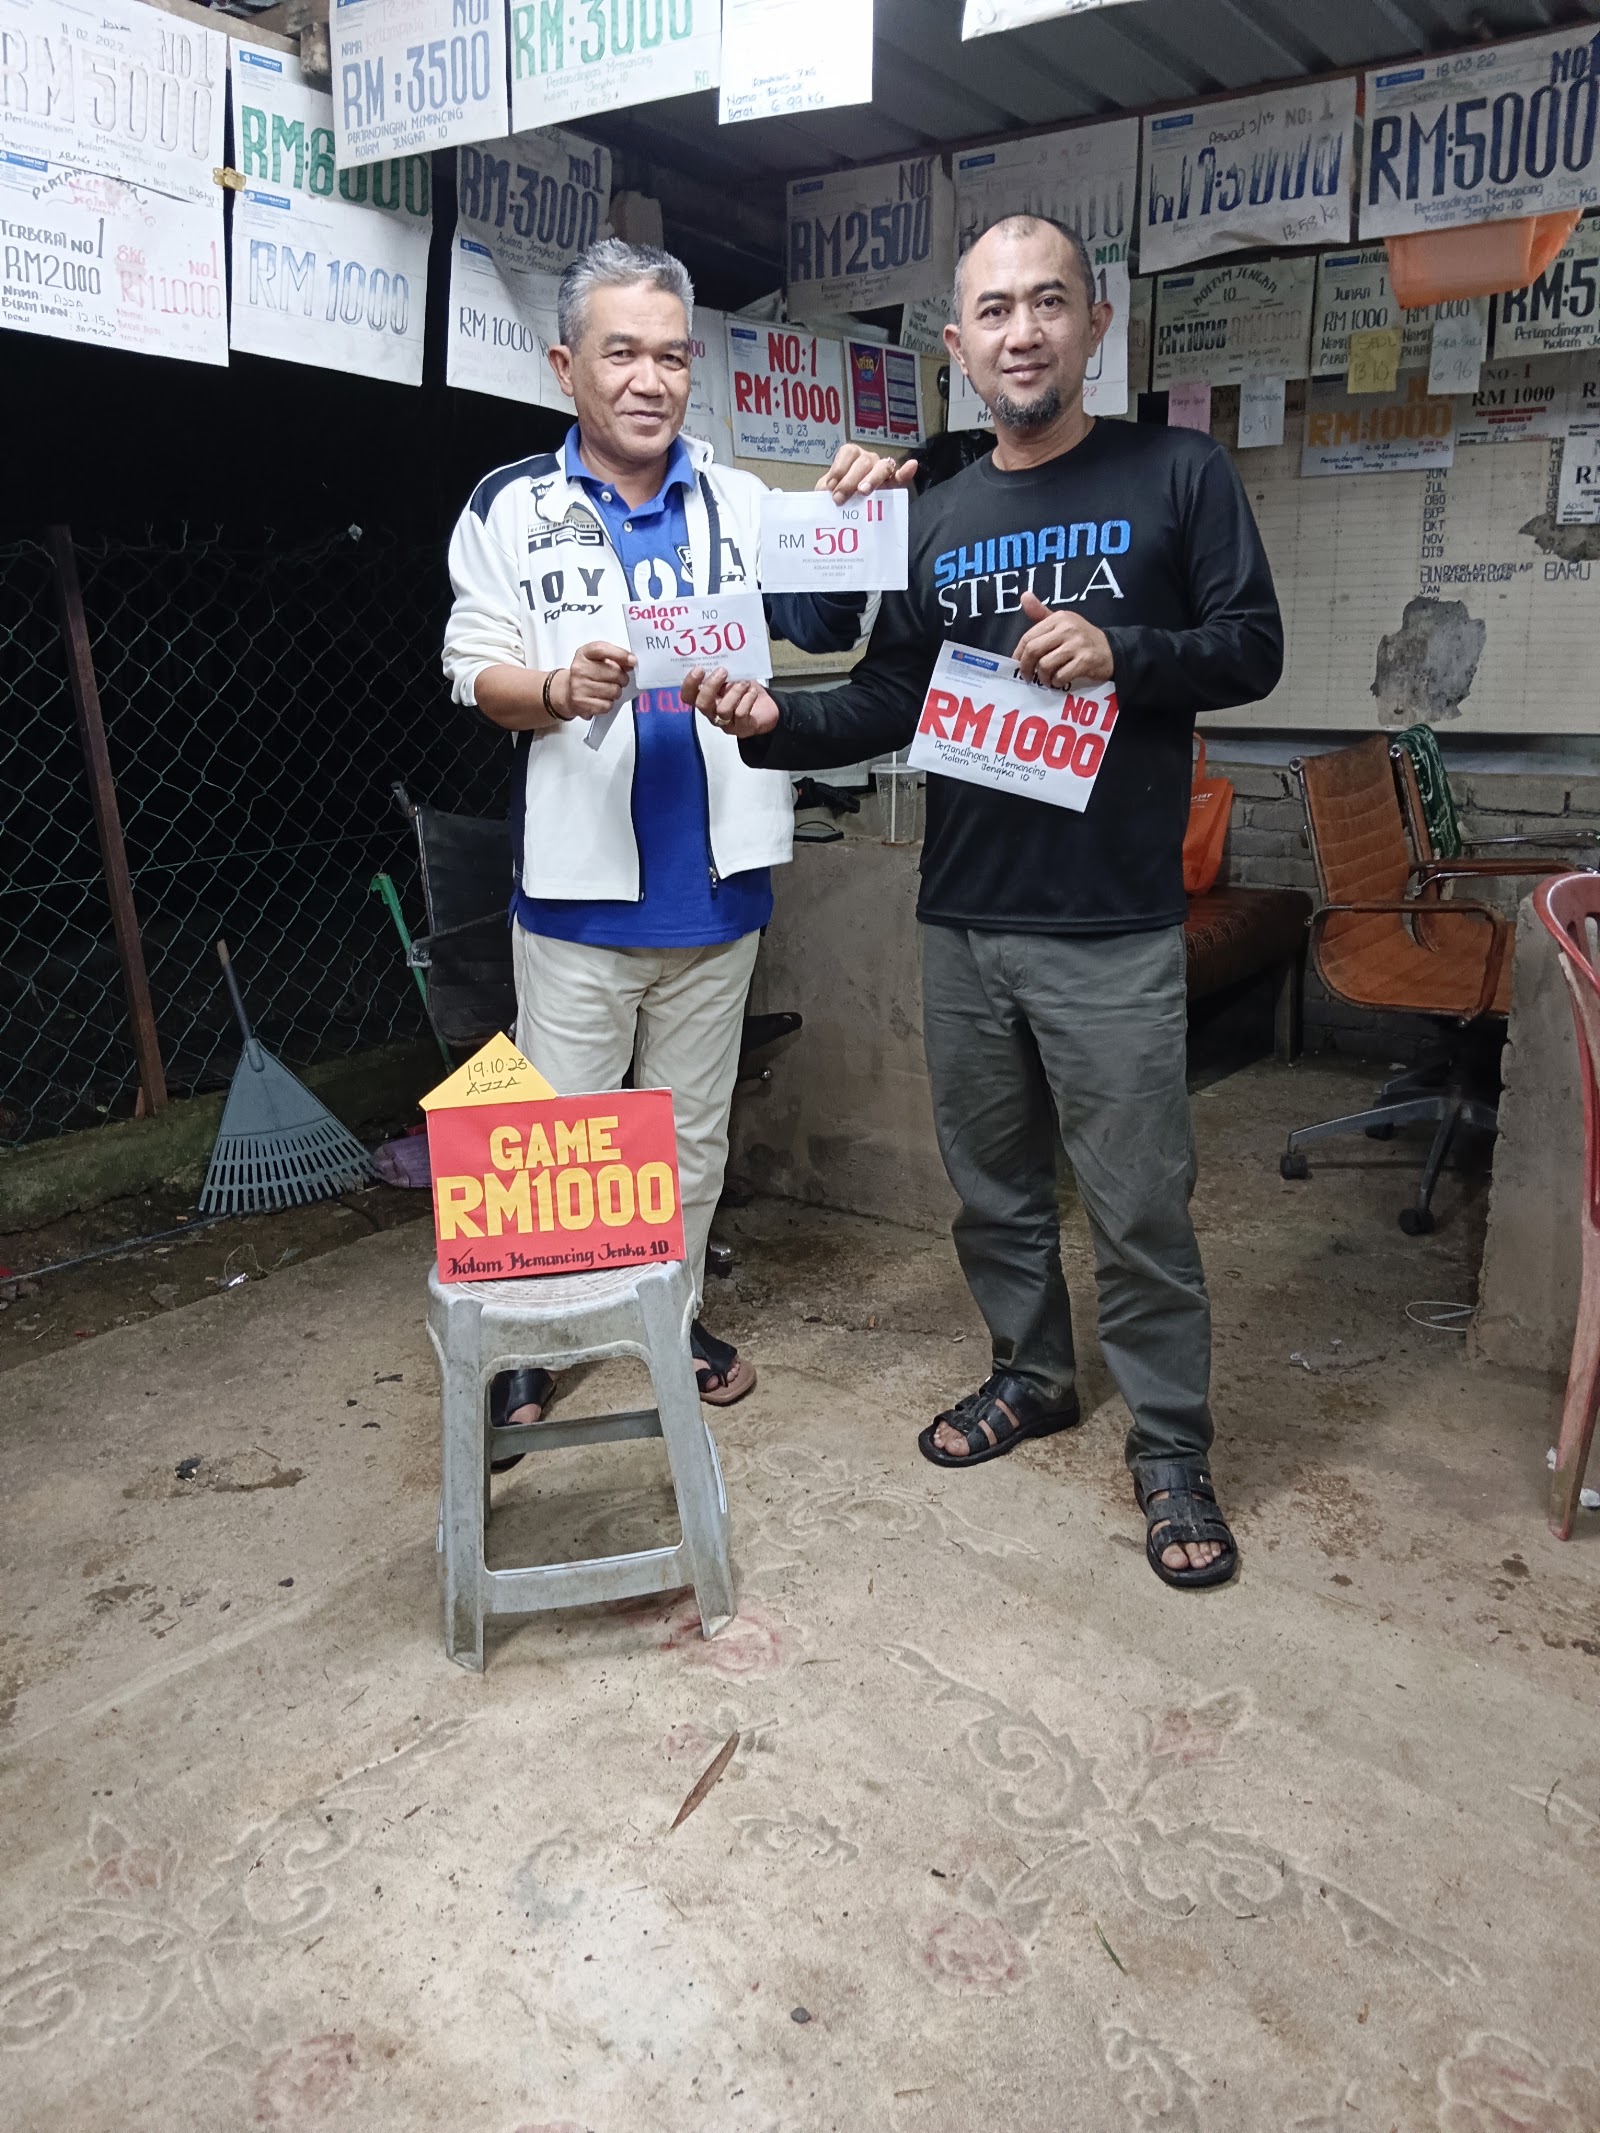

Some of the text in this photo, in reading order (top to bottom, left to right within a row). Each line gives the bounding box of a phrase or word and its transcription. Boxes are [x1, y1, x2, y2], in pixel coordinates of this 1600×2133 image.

[5, 245, 101, 295] RM2000
[842, 510, 860, 520] NO
[778, 527, 859, 555] RM 50
[934, 519, 1131, 588] SHIMANO
[628, 605, 718, 621] Salam NO
[937, 557, 1125, 627] STELLA
[645, 621, 746, 656] RM 330
[918, 687, 1106, 778] RM 1000
[489, 1115, 622, 1171] GAME
[436, 1161, 676, 1240] RM1000
[502, 1247, 595, 1271] Memancing
